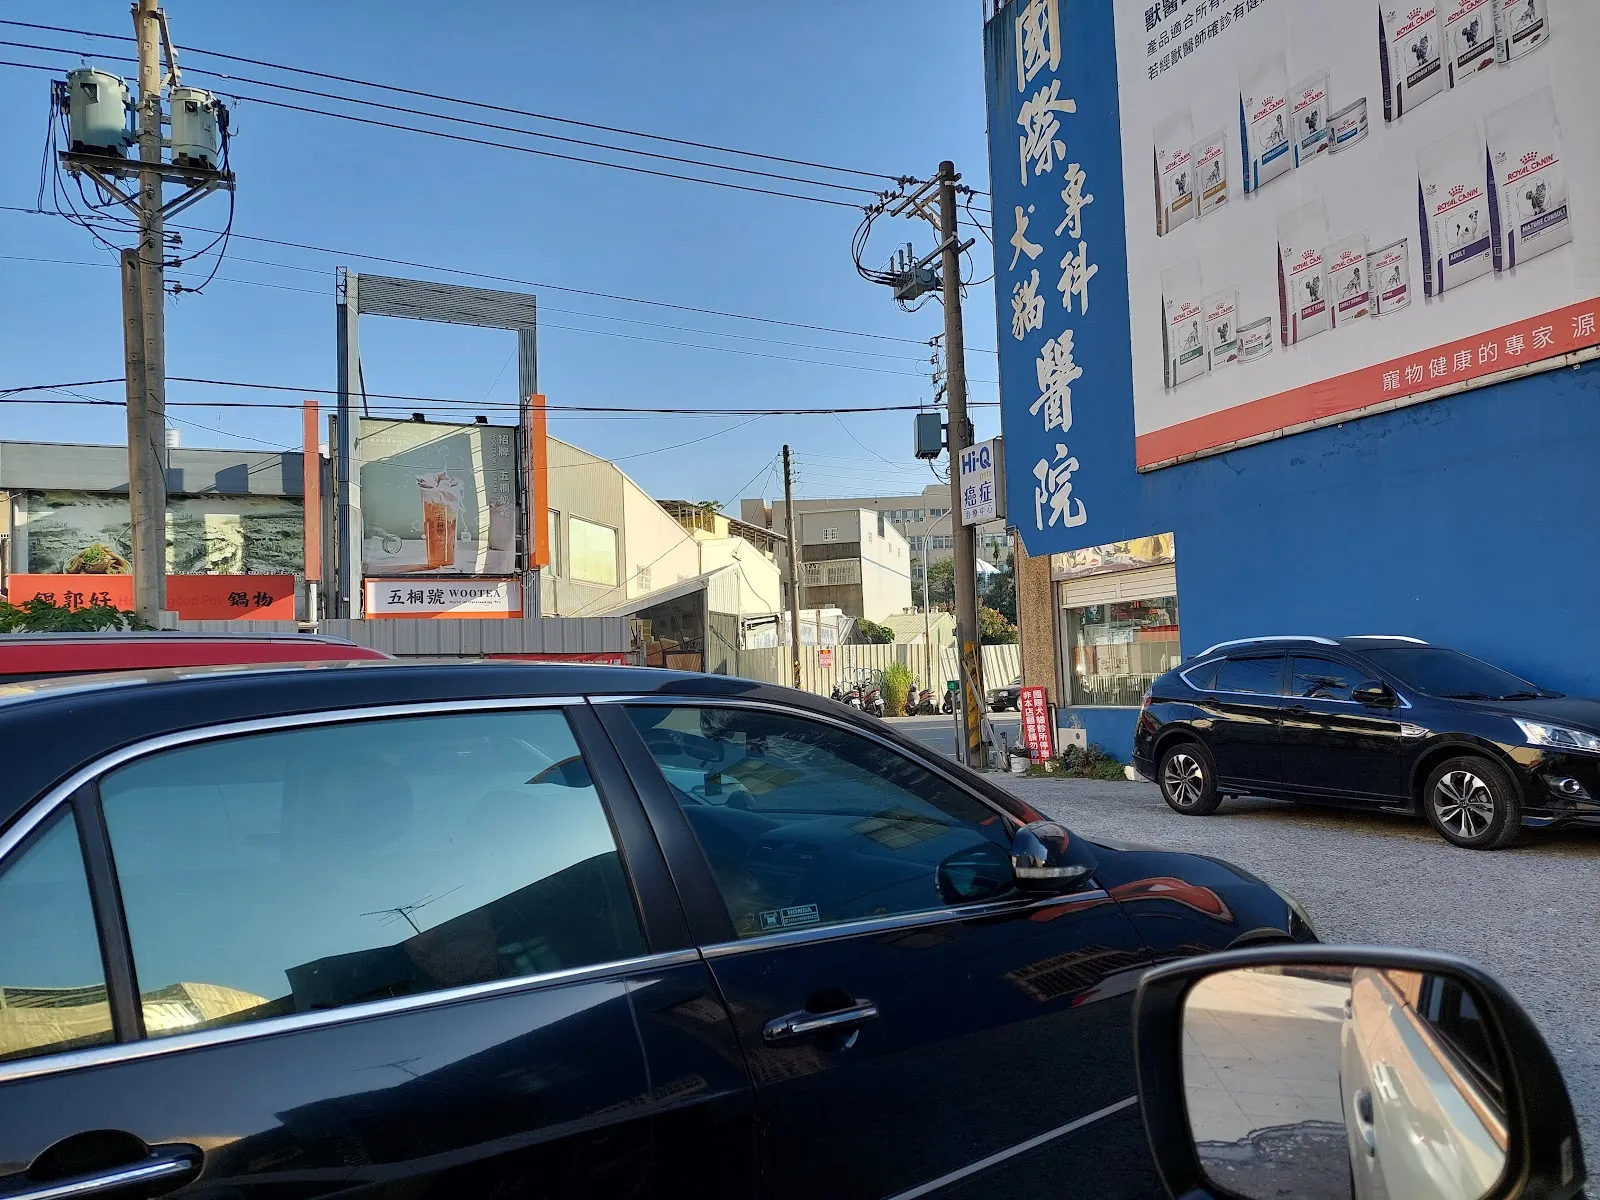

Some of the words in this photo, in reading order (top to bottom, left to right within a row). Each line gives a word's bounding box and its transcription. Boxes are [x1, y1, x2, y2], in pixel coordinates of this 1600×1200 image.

[1144, 0, 1187, 32] 獸醫
[1146, 0, 1226, 58] 產品適合所有
[1396, 21, 1416, 37] ROYAL
[1416, 7, 1435, 24] CANIN
[1147, 0, 1267, 81] 若經獸醫師確診有健
[1015, 0, 1077, 187] 國際
[1507, 166, 1530, 181] ROYAL
[1531, 154, 1553, 169] CANIN
[1437, 198, 1458, 212] ROYAL
[1458, 187, 1479, 202] CANIN
[1522, 217, 1544, 233] MATURE
[1543, 207, 1566, 225] CONSULT
[1008, 203, 1046, 342] 犬貓
[1293, 260, 1310, 272] ROYAL
[1382, 324, 1554, 392] 寵物健康的專家
[1571, 312, 1596, 339] 源
[1028, 329, 1088, 531] 醫院
[979, 471, 992, 481] pets
[963, 481, 993, 508] 癌症
[227, 590, 274, 608] 鍋物
[387, 588, 446, 606] 五桐號
[449, 589, 501, 598] WOOTEA
[787, 907, 812, 915] HONDA
